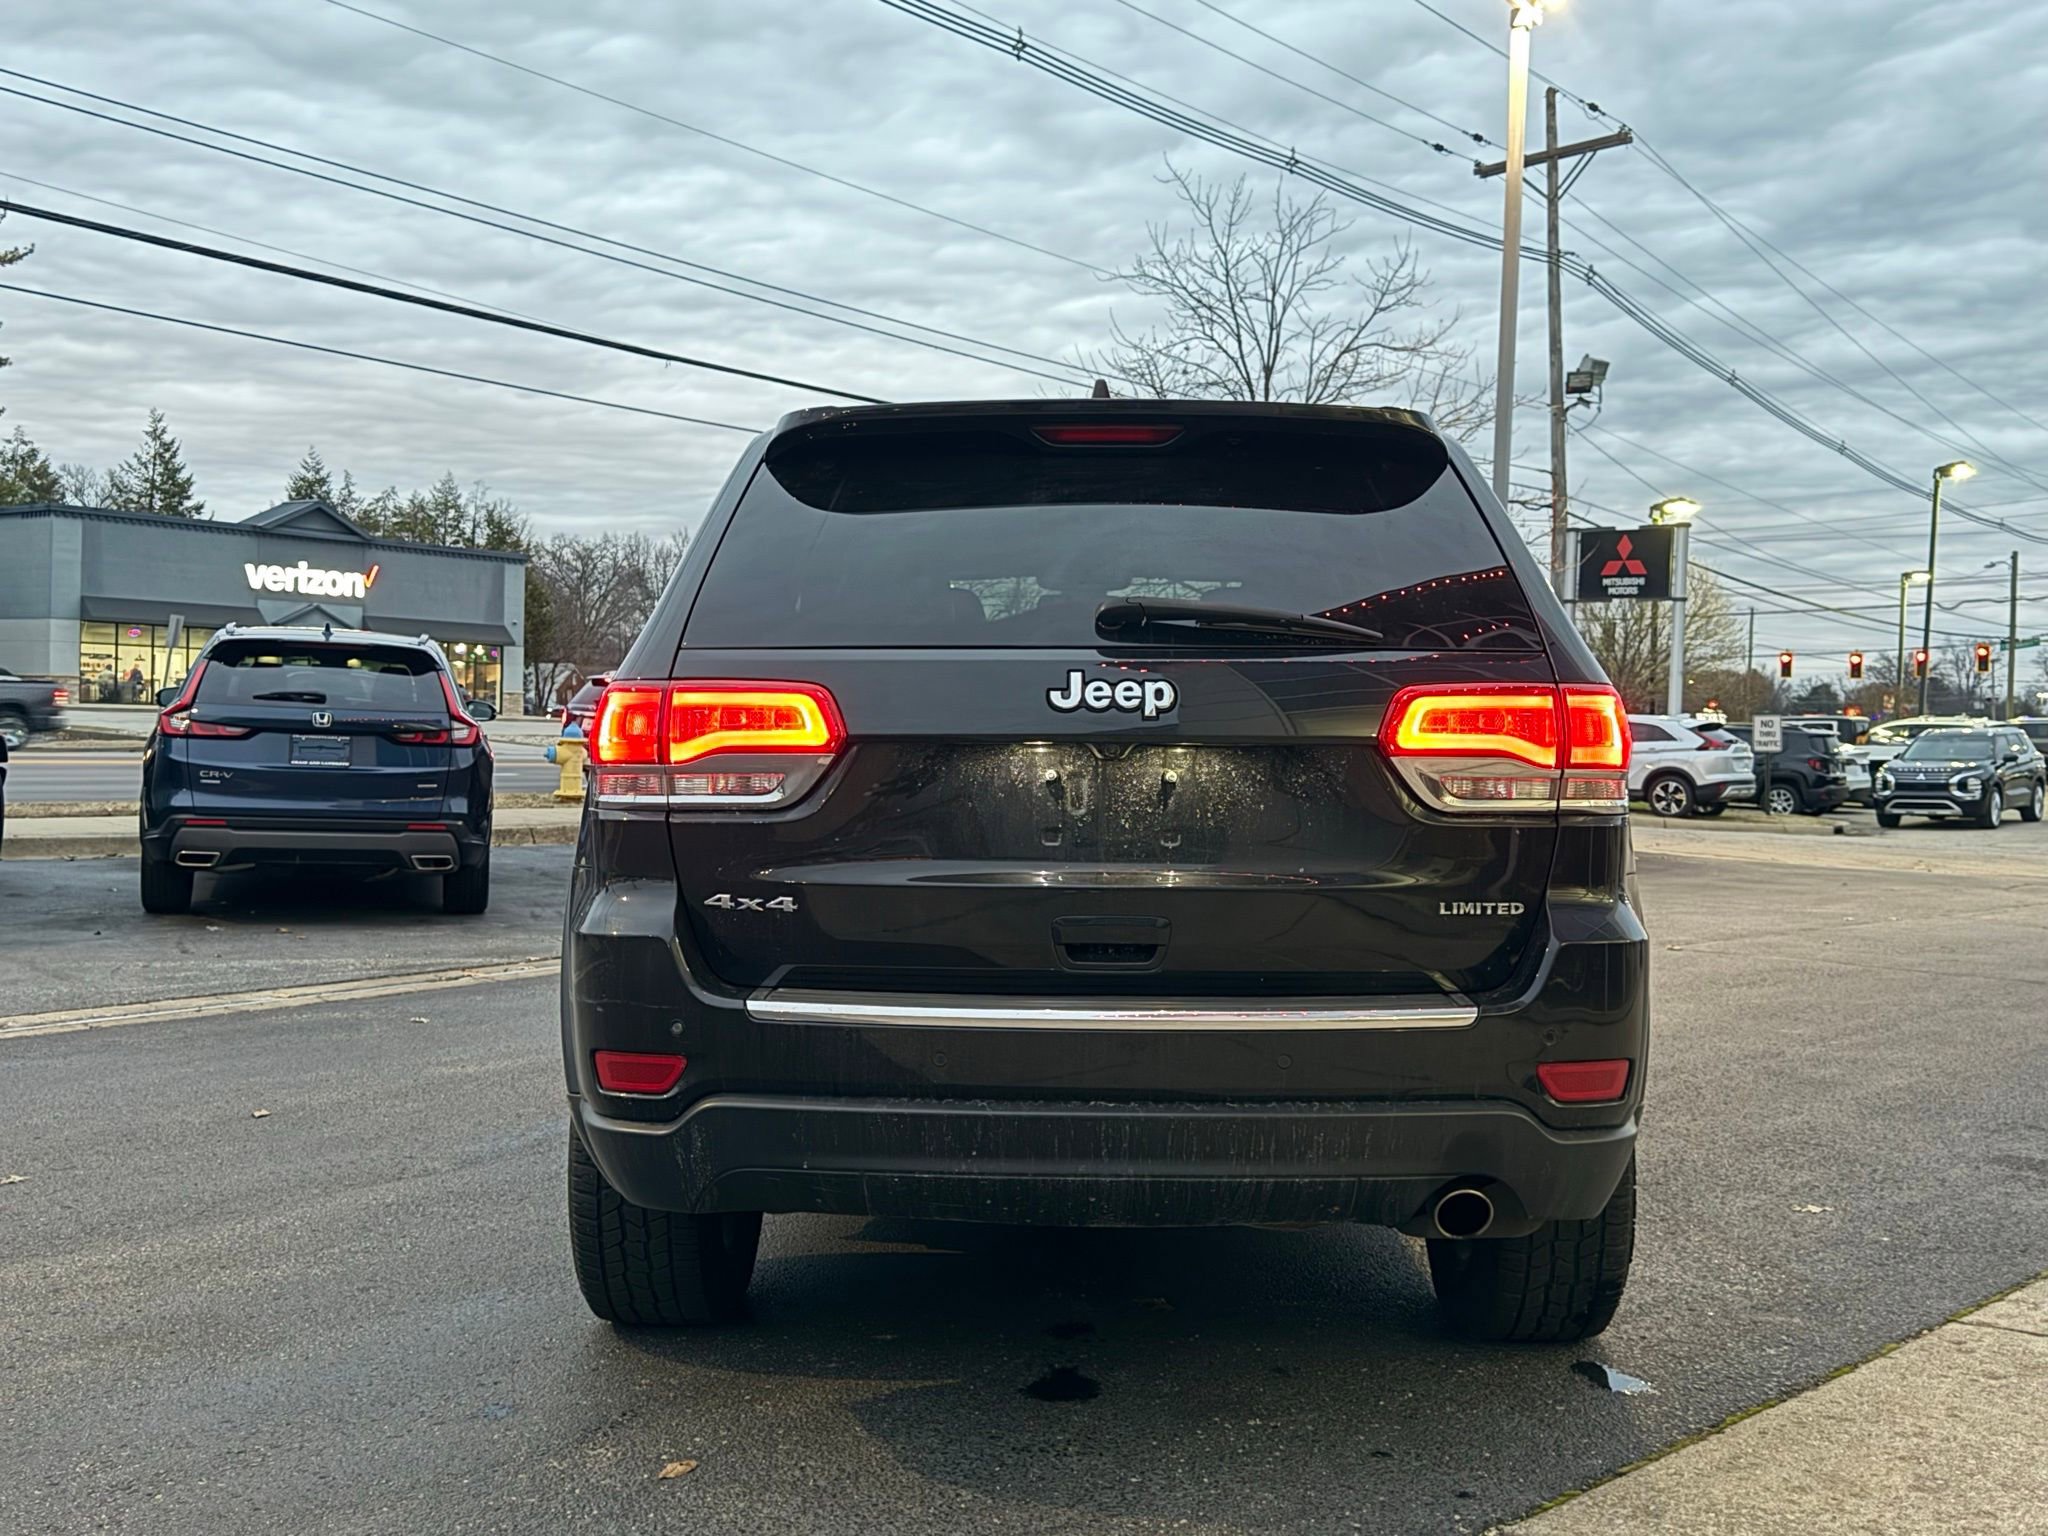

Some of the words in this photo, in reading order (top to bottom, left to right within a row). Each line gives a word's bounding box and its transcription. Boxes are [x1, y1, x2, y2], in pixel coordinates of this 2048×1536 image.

[244, 560, 366, 598] verizon
[1047, 669, 1177, 718] Jeep
[1760, 719, 1775, 728] NO
[1759, 730, 1777, 738] THRU
[703, 893, 799, 912] 4x4
[1439, 901, 1525, 915] LIMITED
